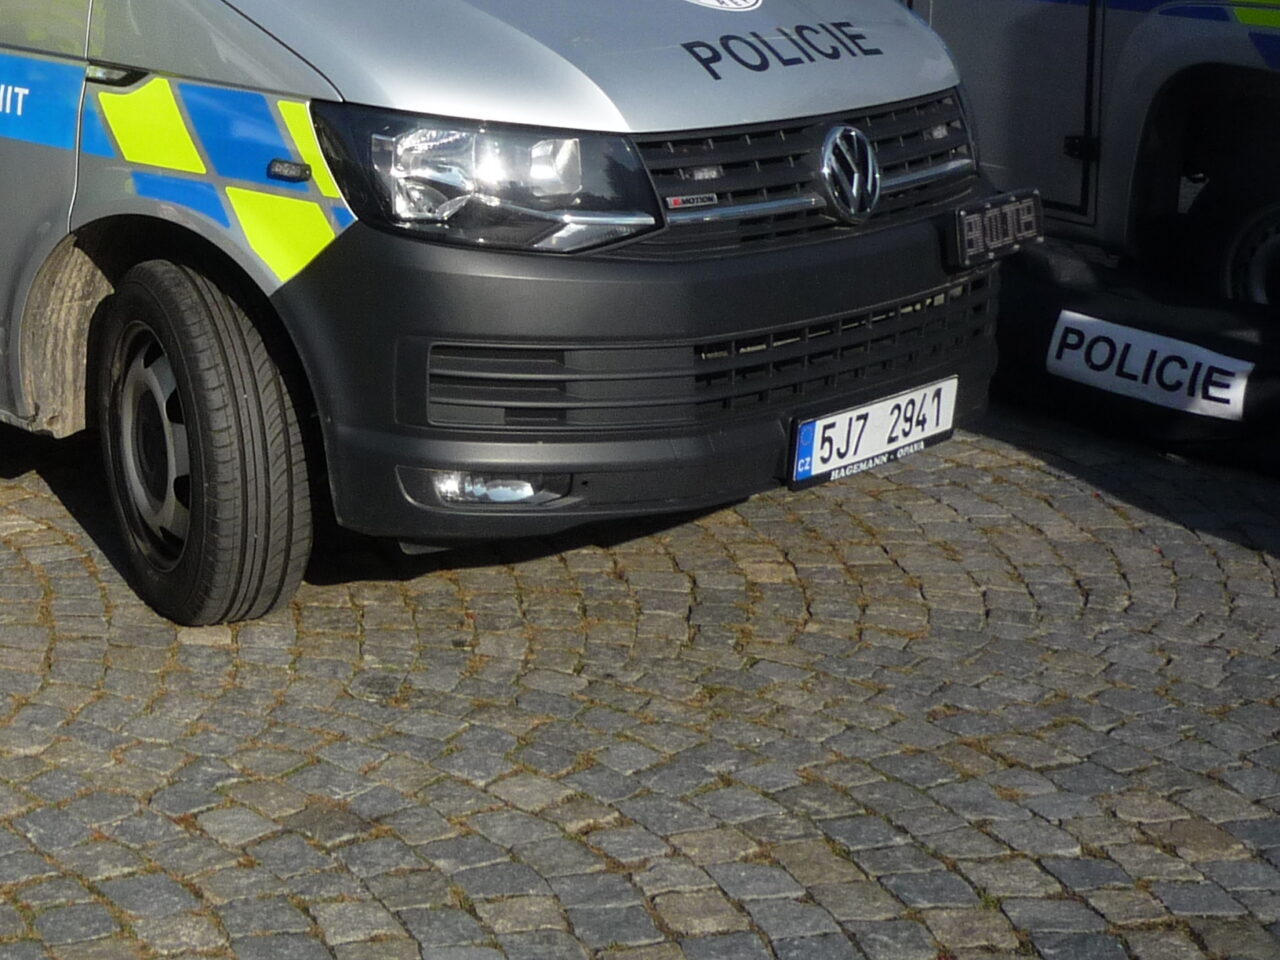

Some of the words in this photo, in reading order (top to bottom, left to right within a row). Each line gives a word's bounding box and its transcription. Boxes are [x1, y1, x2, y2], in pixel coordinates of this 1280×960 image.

[680, 21, 884, 81] POLICIE
[1055, 326, 1237, 405] POLICIE
[820, 412, 869, 464] 5J7
[887, 387, 943, 445] 2941
[798, 458, 811, 472] CZ
[830, 453, 889, 481] HAGEMANN
[896, 441, 925, 459] OPAVA
